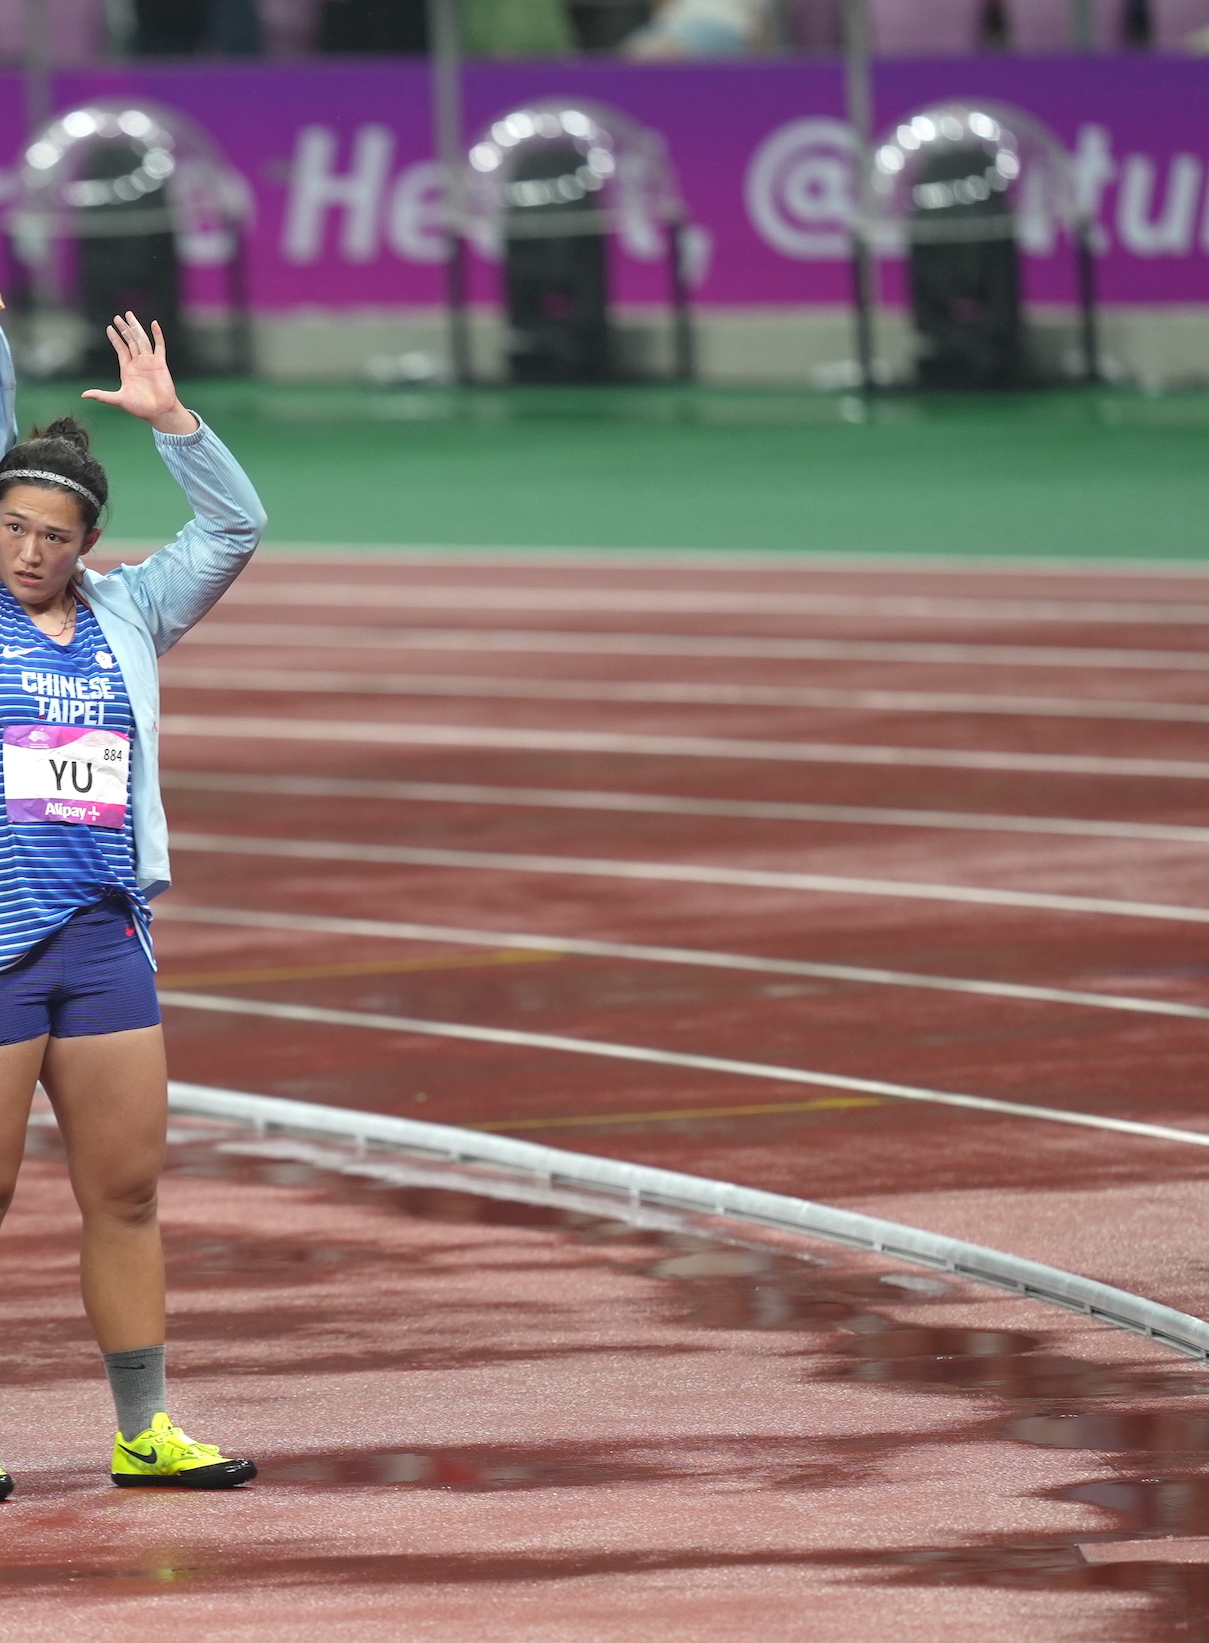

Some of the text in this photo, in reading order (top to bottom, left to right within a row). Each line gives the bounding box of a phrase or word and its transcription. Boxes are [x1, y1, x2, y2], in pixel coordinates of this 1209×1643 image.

[283, 122, 713, 288] Het,
[21, 671, 115, 699] CHINESE
[34, 696, 104, 725] TAIPEI
[103, 748, 122, 762] 884
[48, 759, 93, 793] YU
